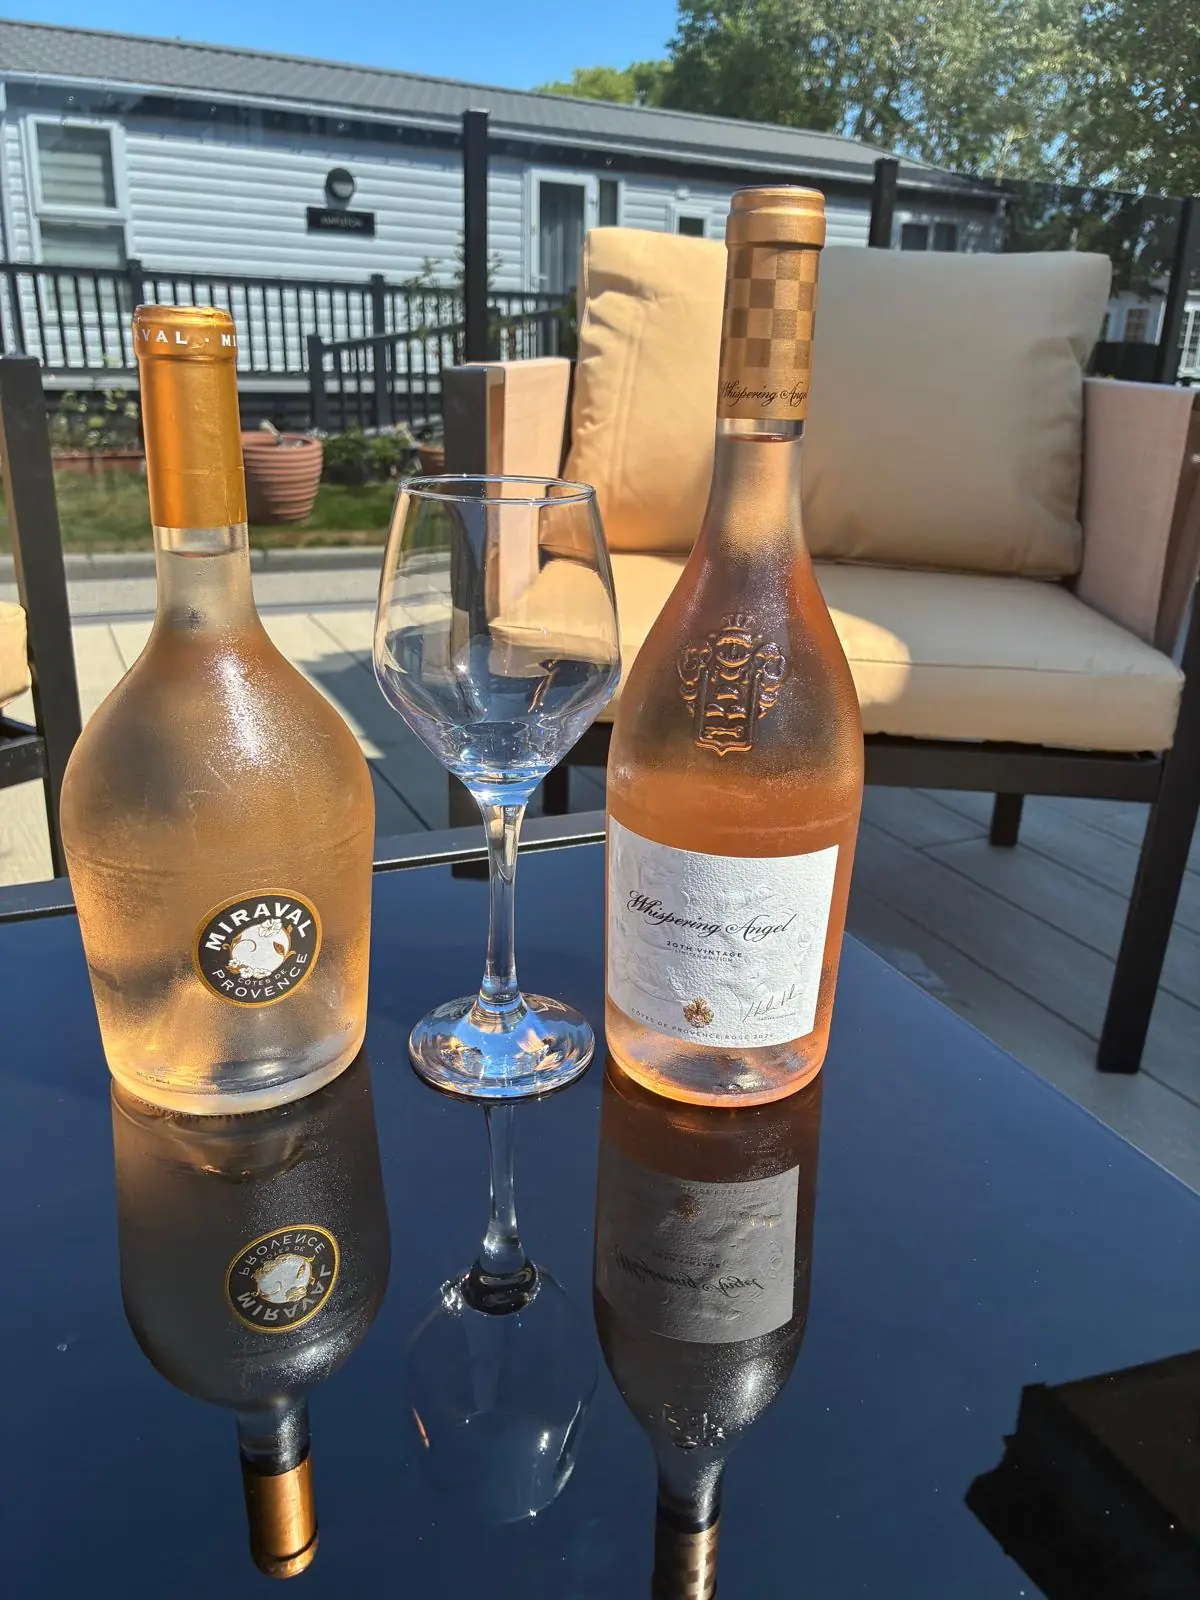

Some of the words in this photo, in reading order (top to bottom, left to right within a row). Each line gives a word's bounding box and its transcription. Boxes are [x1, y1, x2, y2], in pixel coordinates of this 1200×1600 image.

[721, 379, 779, 408] Whispering
[205, 902, 312, 952] MIRAVAL
[626, 890, 722, 938] Whispering
[725, 913, 798, 943] Angel
[666, 940, 692, 952] 20TH
[696, 947, 742, 958] VINTAGE
[211, 953, 308, 999] PROVENCE
[274, 968, 287, 979] DE
